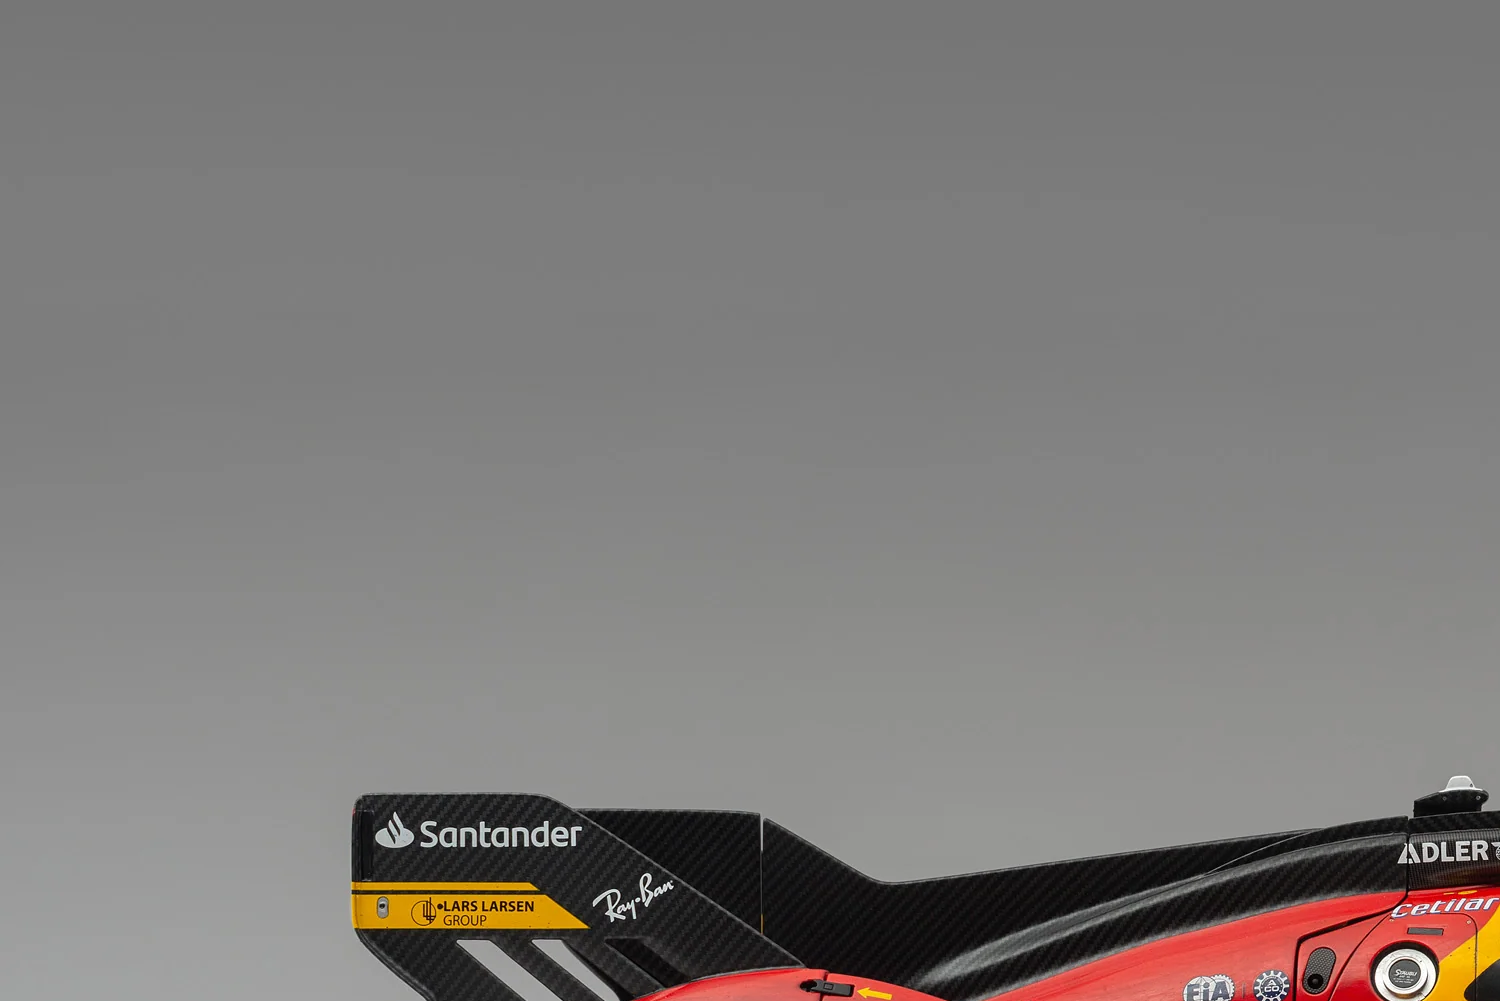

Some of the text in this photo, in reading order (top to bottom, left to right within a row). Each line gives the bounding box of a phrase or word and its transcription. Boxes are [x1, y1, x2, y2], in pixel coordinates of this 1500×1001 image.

[419, 820, 583, 848] Santander
[1397, 839, 1489, 865] ADLER
[443, 900, 535, 912] LARS LARSEN
[443, 914, 487, 927] GROUP
